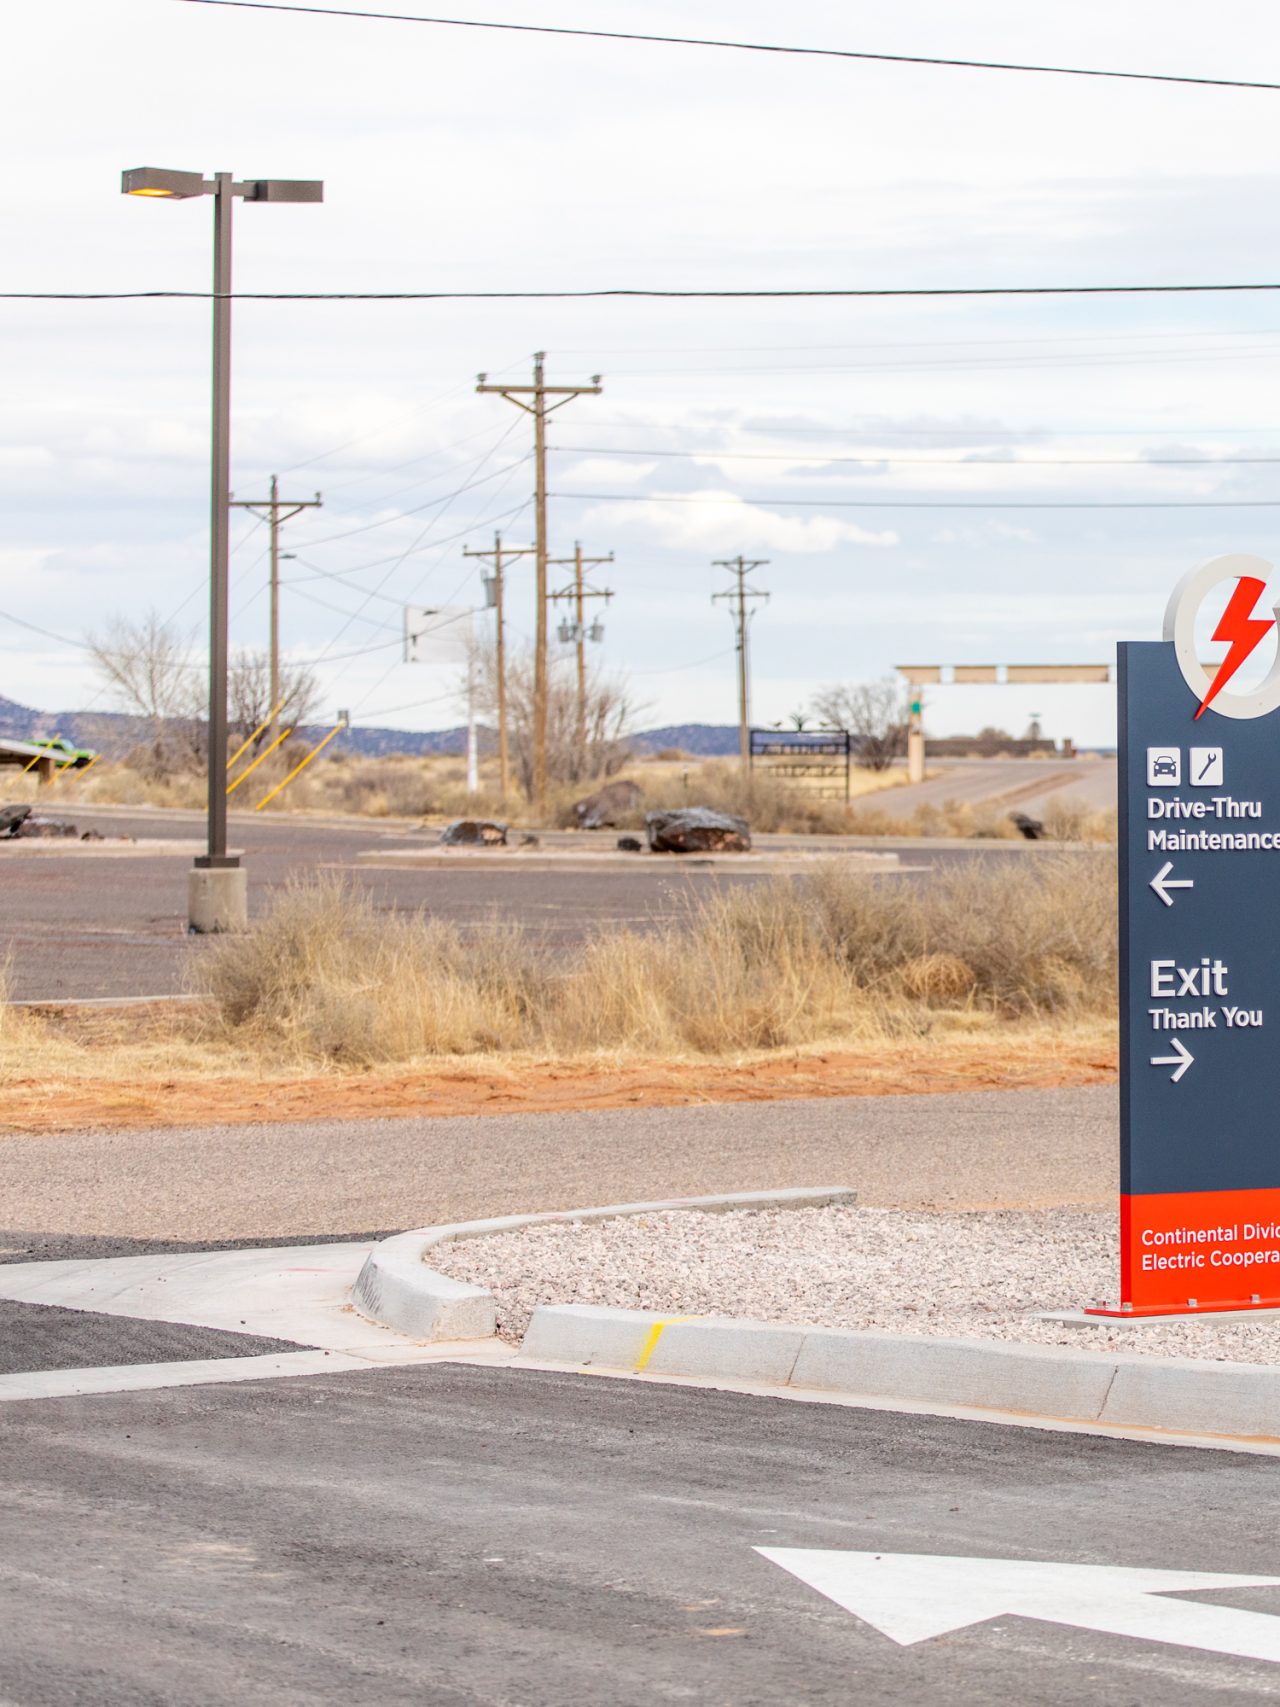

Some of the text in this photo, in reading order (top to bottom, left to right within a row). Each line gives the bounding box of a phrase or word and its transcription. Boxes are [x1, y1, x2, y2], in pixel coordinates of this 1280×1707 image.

[1147, 796, 1263, 820] Drive-Thru
[1150, 957, 1229, 998] Exit
[1148, 1006, 1264, 1031] Thank You
[1141, 1224, 1239, 1247] Continental
[1142, 1251, 1206, 1272] Electric
